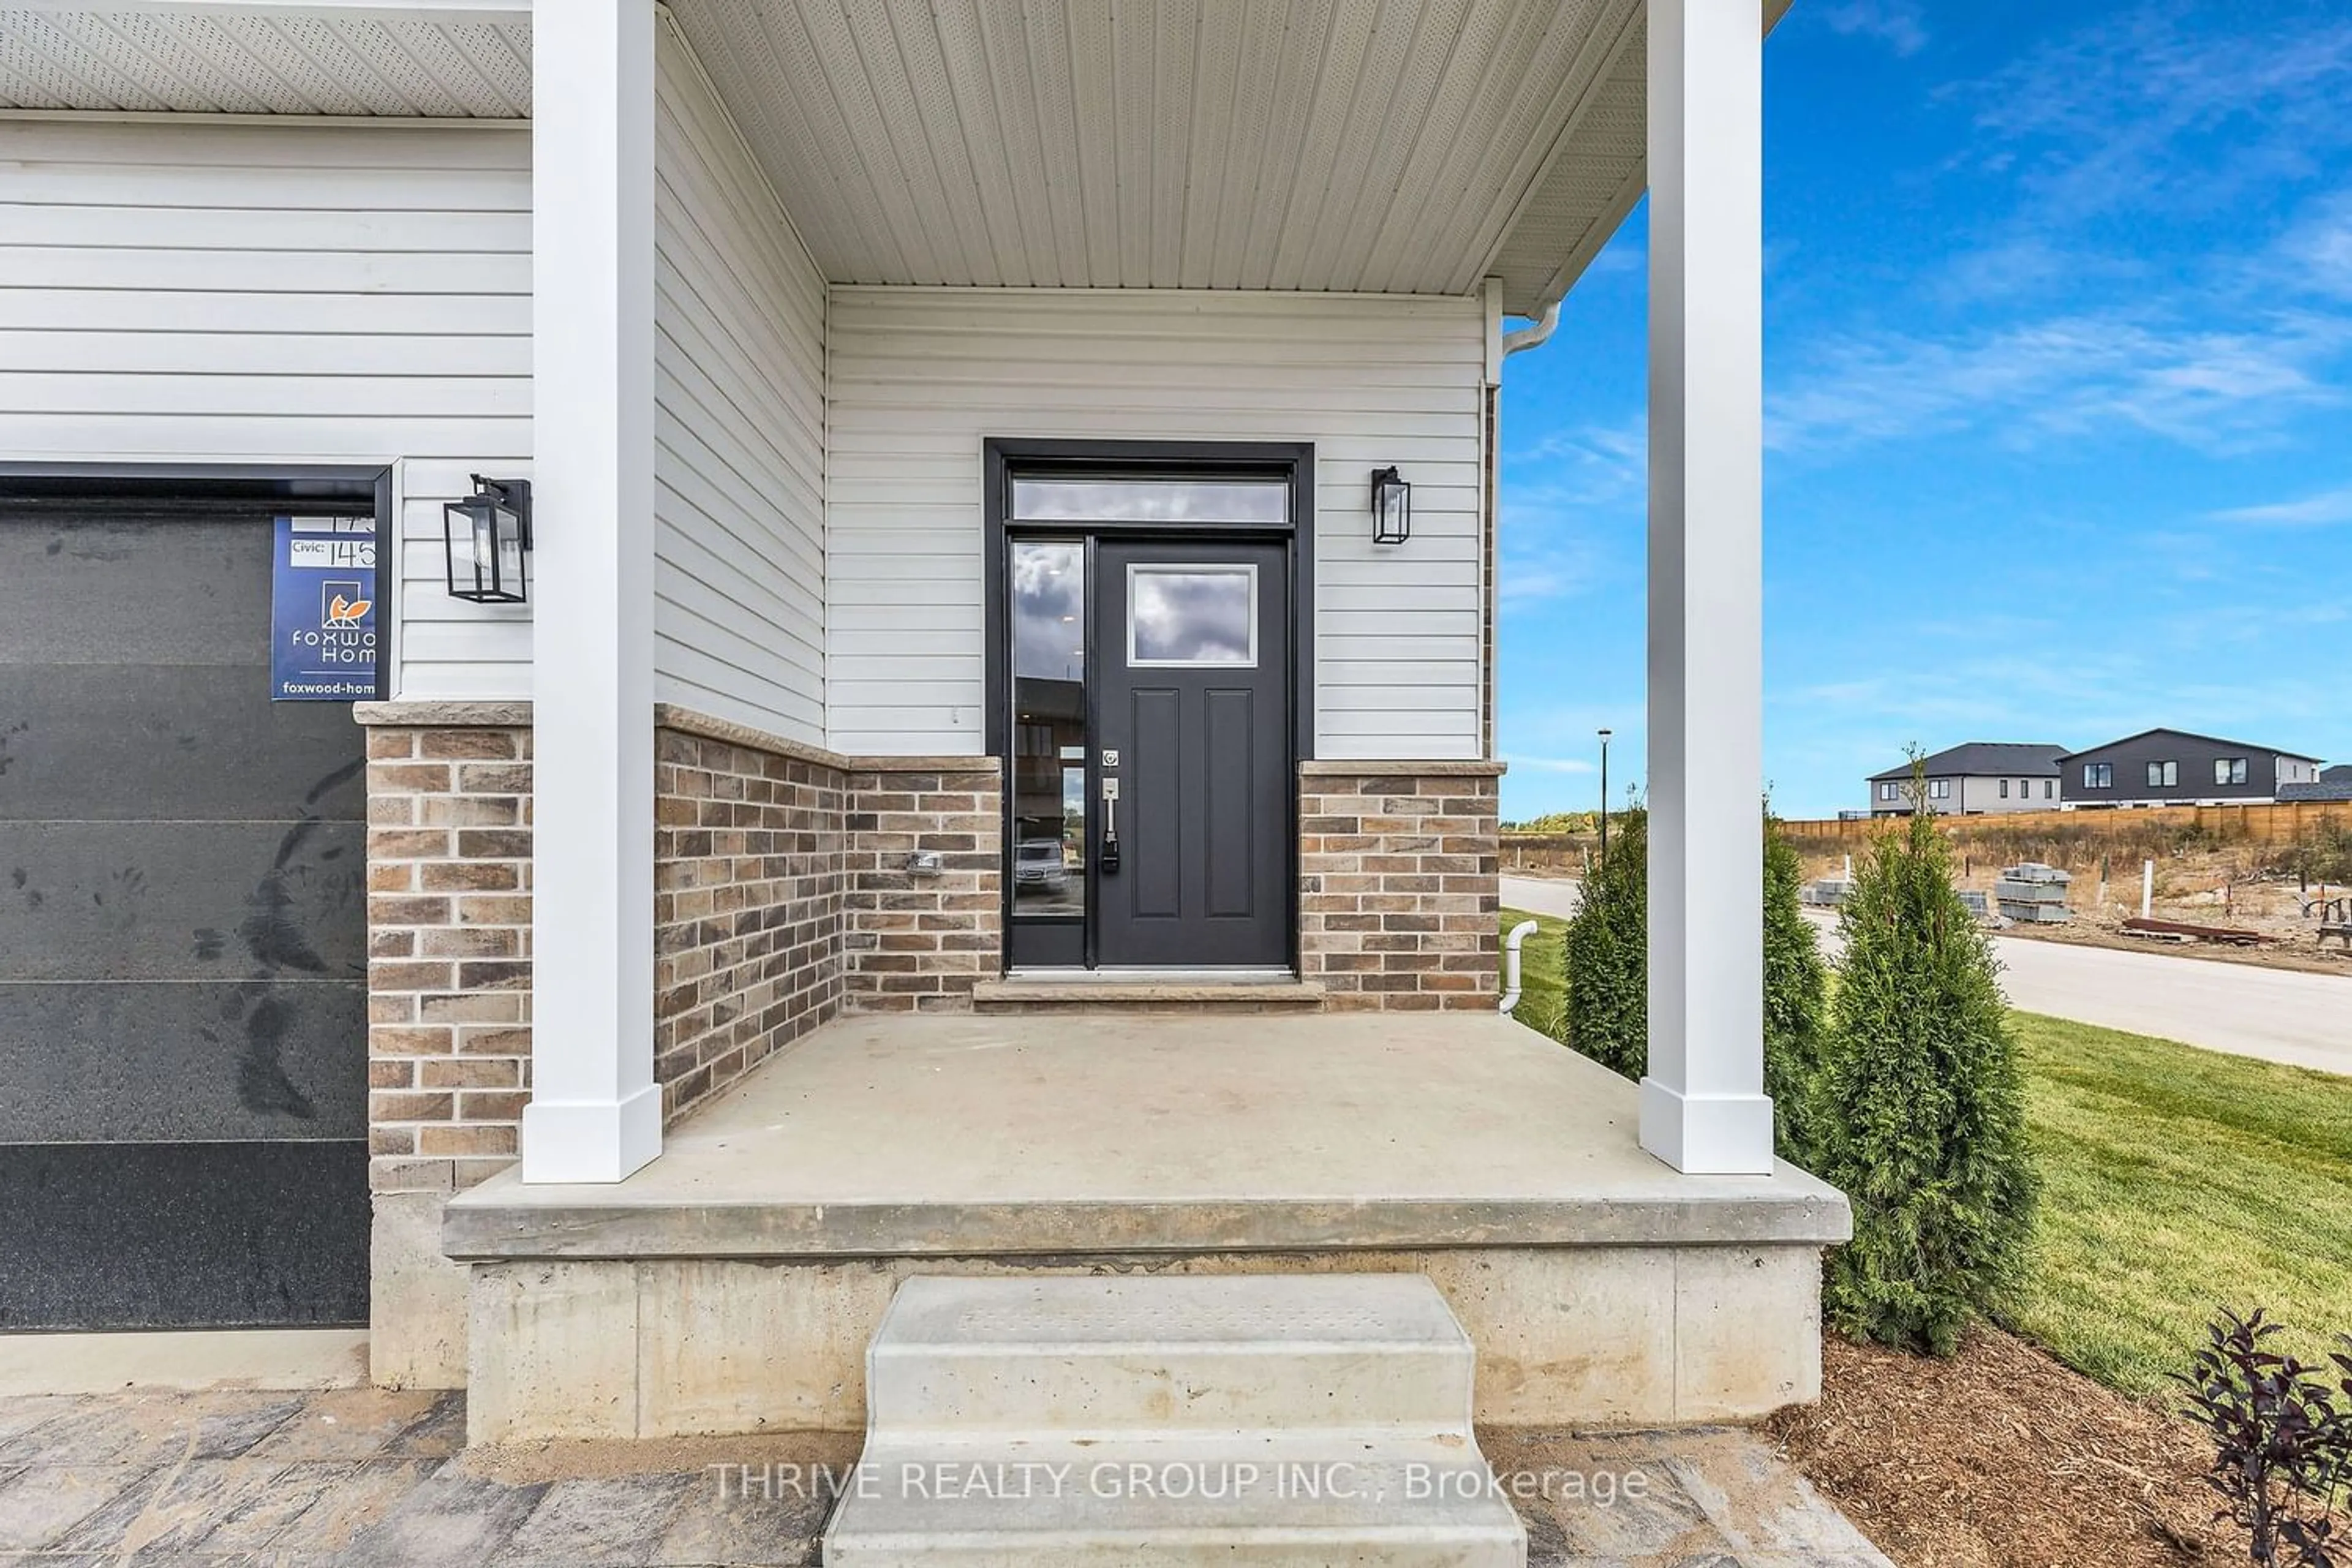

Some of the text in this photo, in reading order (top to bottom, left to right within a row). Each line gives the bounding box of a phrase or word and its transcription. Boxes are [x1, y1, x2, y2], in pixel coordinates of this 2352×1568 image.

[293, 542, 375, 567] Civic: 145
[283, 681, 375, 693] foxwood-hom
